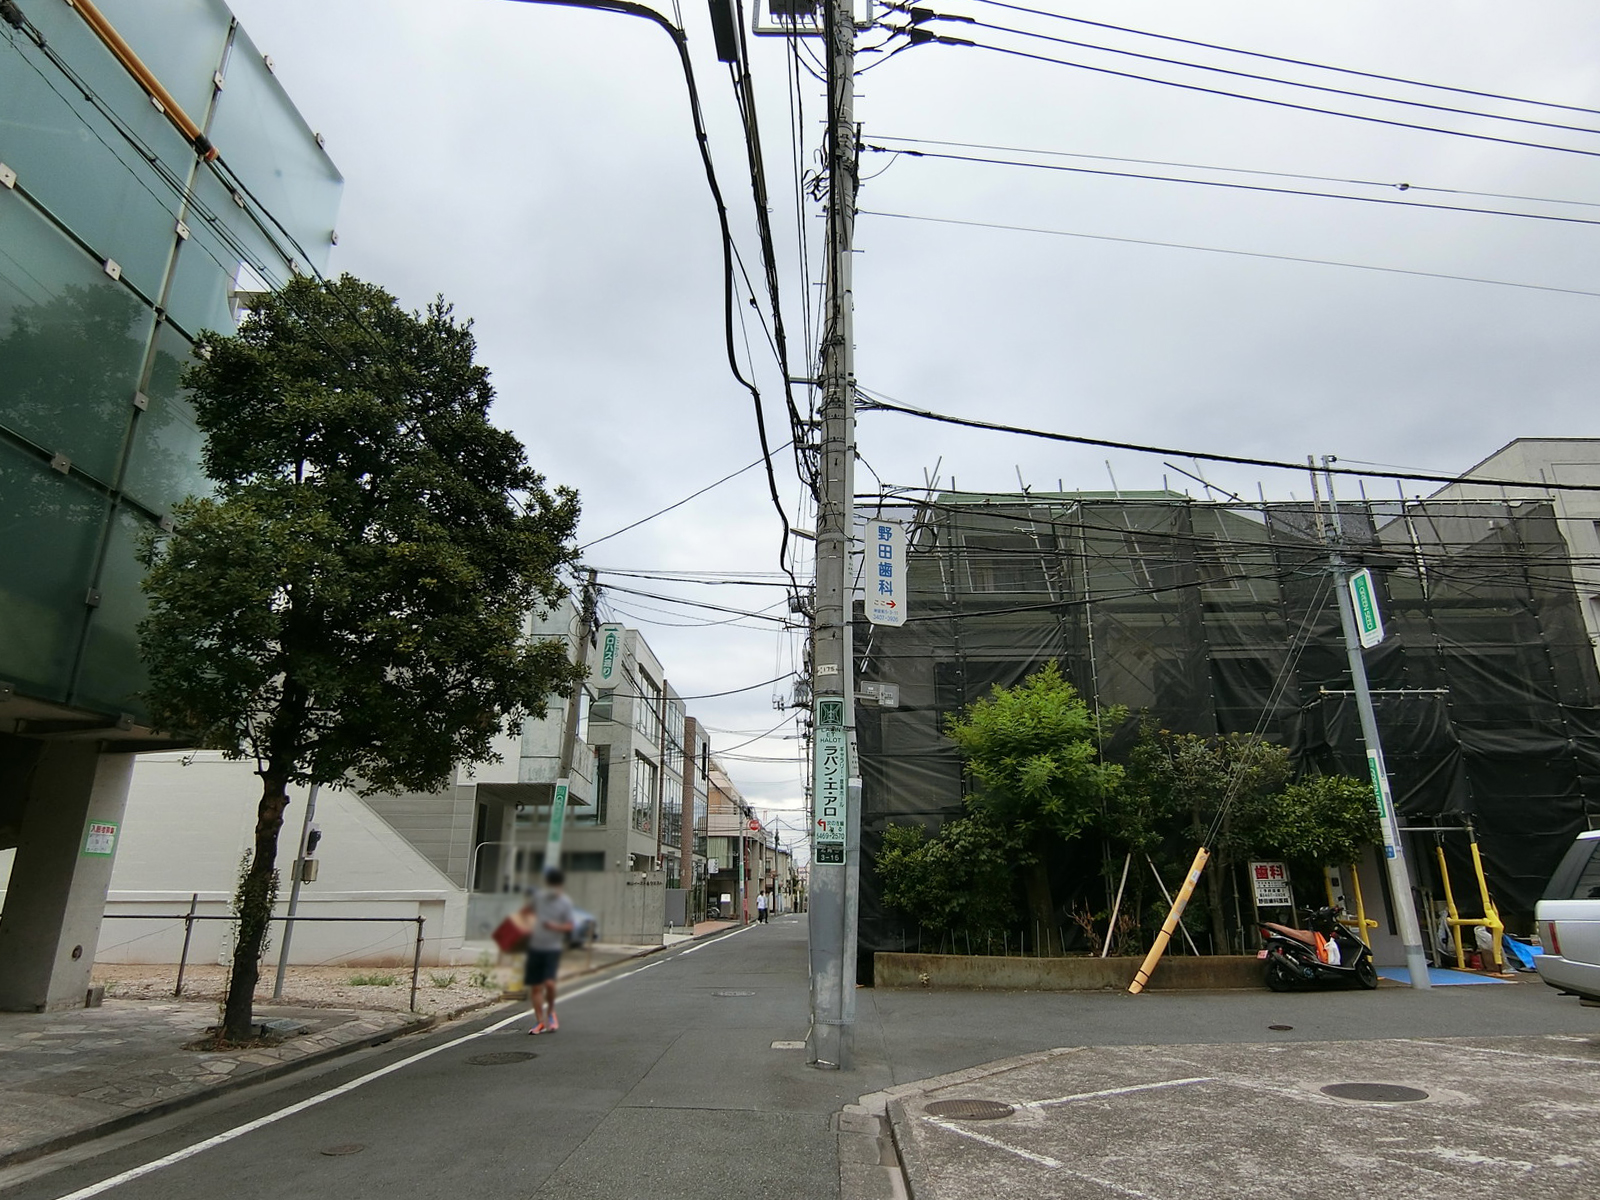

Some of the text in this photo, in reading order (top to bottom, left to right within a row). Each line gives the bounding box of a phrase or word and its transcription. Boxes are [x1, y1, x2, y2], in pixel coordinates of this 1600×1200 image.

[878, 525, 893, 597] 野田歯科
[823, 745, 838, 816] ラパン・エ・アロ
[1255, 865, 1284, 879] 歯科
